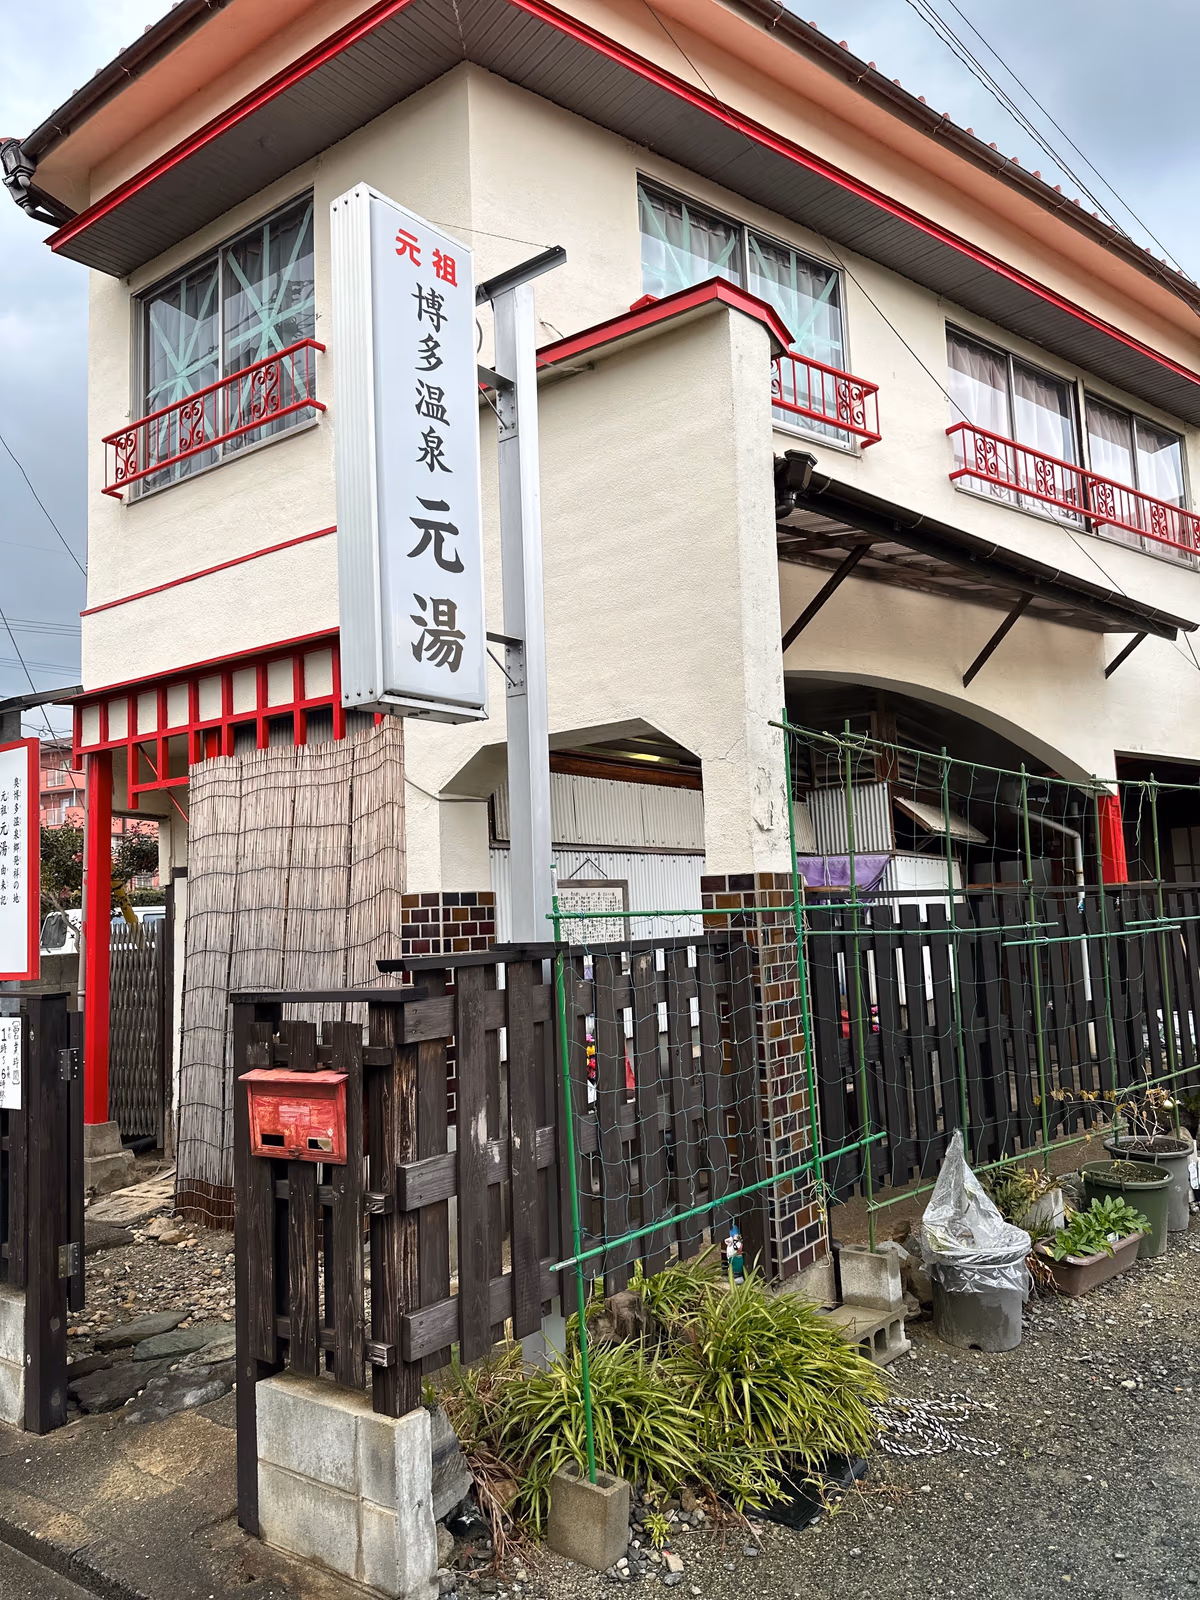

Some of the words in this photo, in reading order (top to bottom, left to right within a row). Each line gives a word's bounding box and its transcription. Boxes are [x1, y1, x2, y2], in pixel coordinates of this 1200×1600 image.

[395, 228, 458, 288] 元祖
[411, 282, 454, 474] 博多温泉
[406, 495, 466, 674] 元湯
